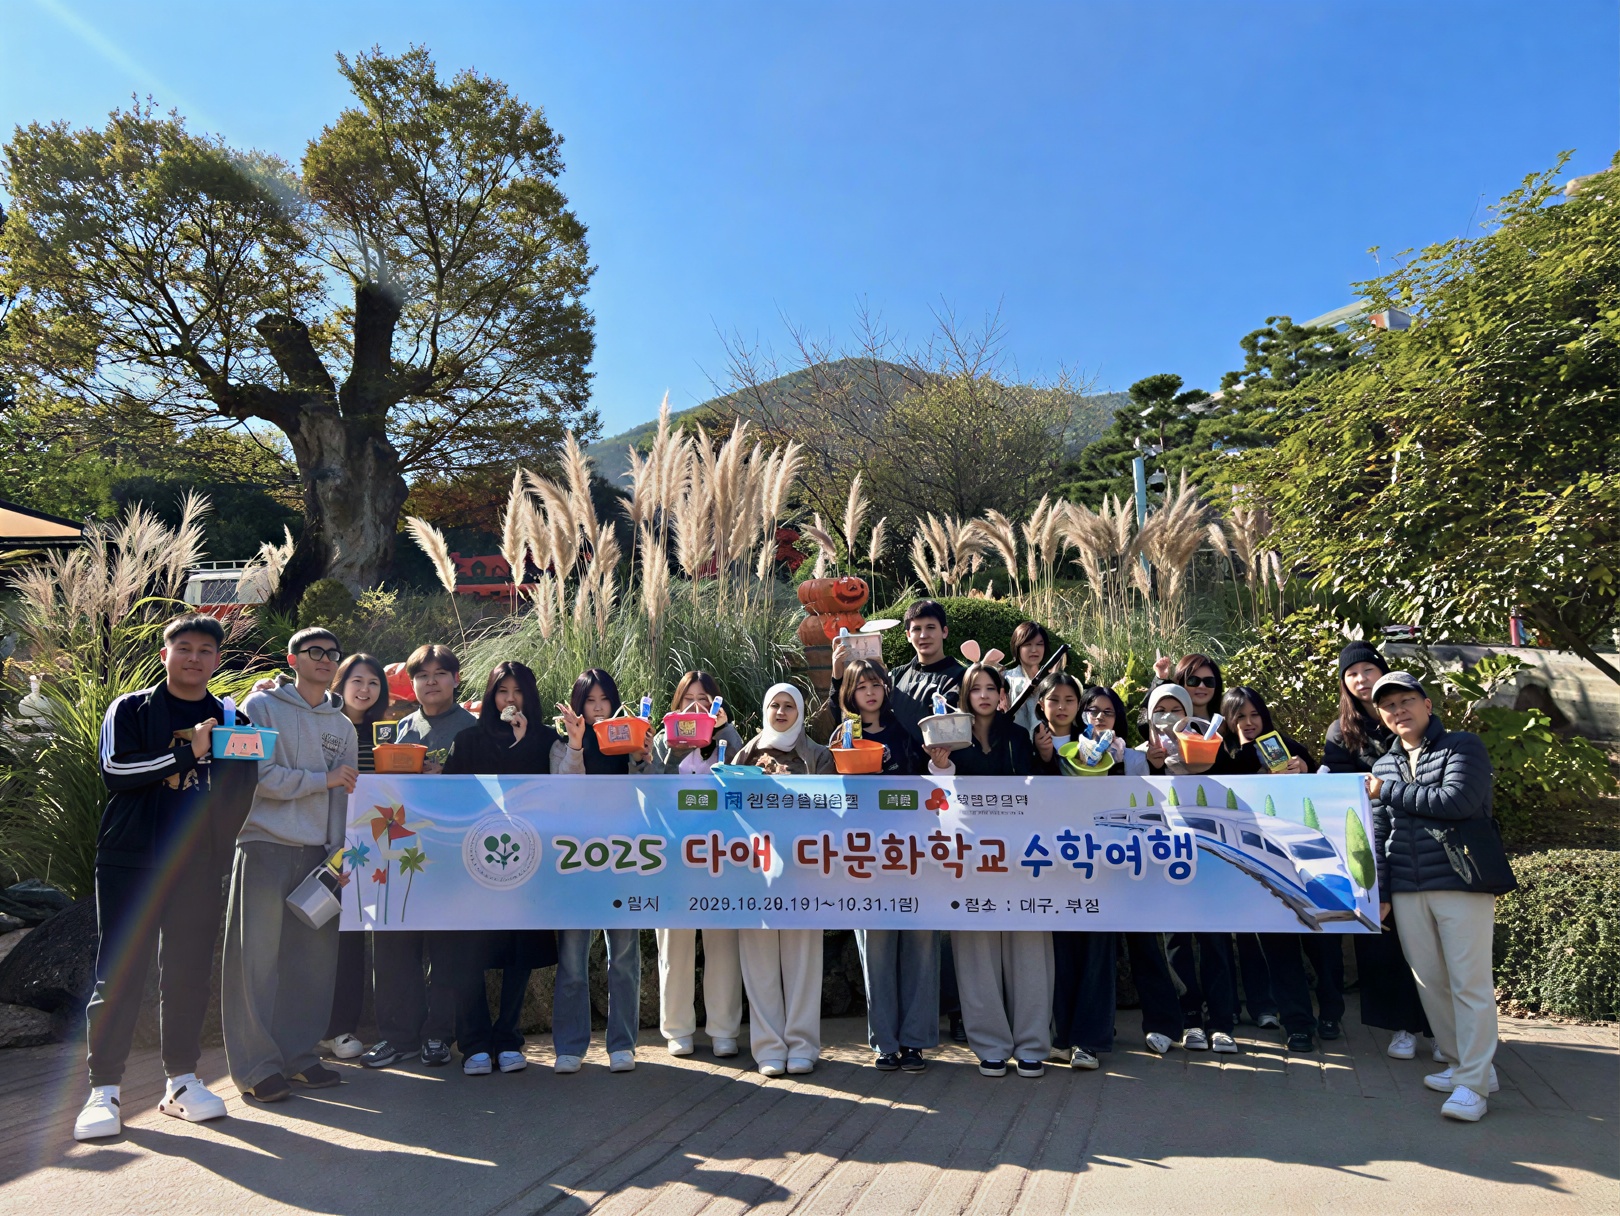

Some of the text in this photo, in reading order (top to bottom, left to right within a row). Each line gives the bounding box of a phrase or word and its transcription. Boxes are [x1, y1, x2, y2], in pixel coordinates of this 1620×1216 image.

[555, 838, 663, 871] 2025
[685, 833, 771, 874] 다애
[797, 830, 1009, 879] 다문화학교
[1020, 829, 1194, 880] 수학여행
